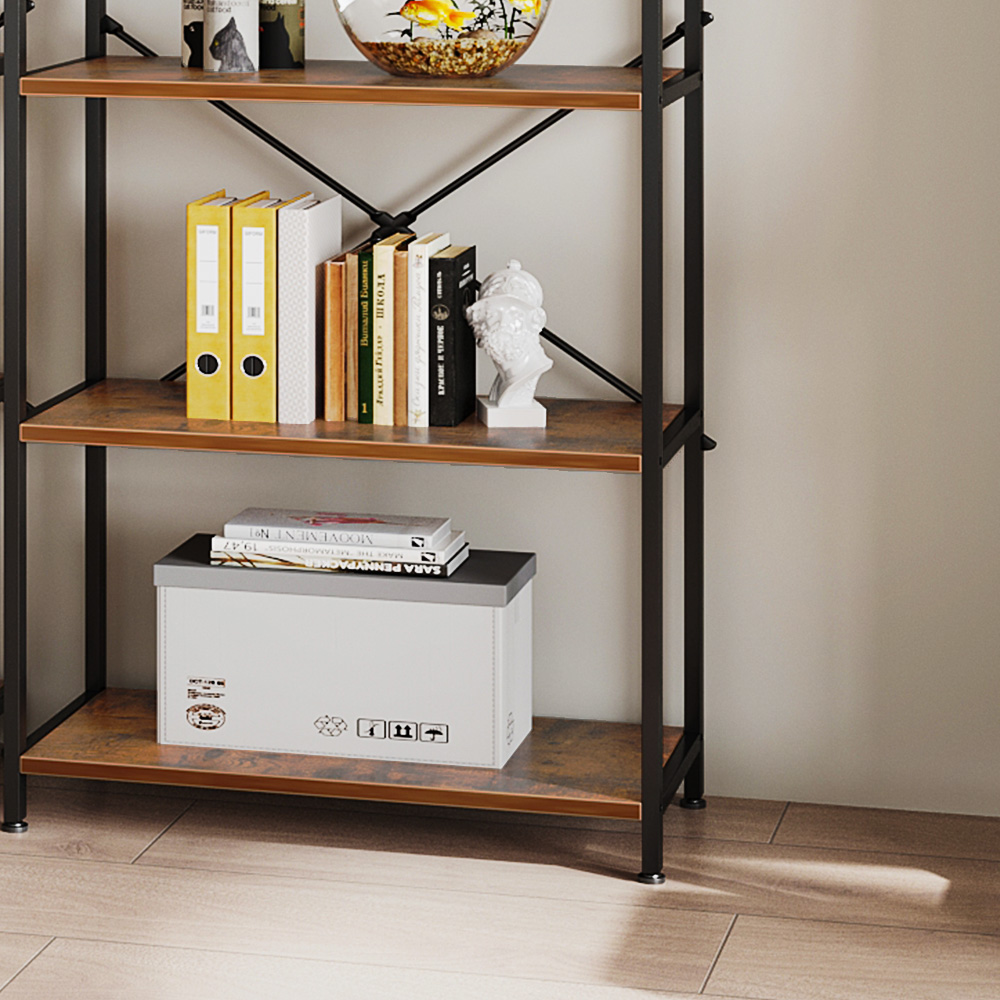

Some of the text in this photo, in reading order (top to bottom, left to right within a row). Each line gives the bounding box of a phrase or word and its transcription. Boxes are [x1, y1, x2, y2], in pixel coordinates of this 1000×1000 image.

[360, 260, 369, 298] Бианки
[376, 273, 386, 319] ШКОЛА
[303, 558, 442, 575] SARA PENNYPACKER
